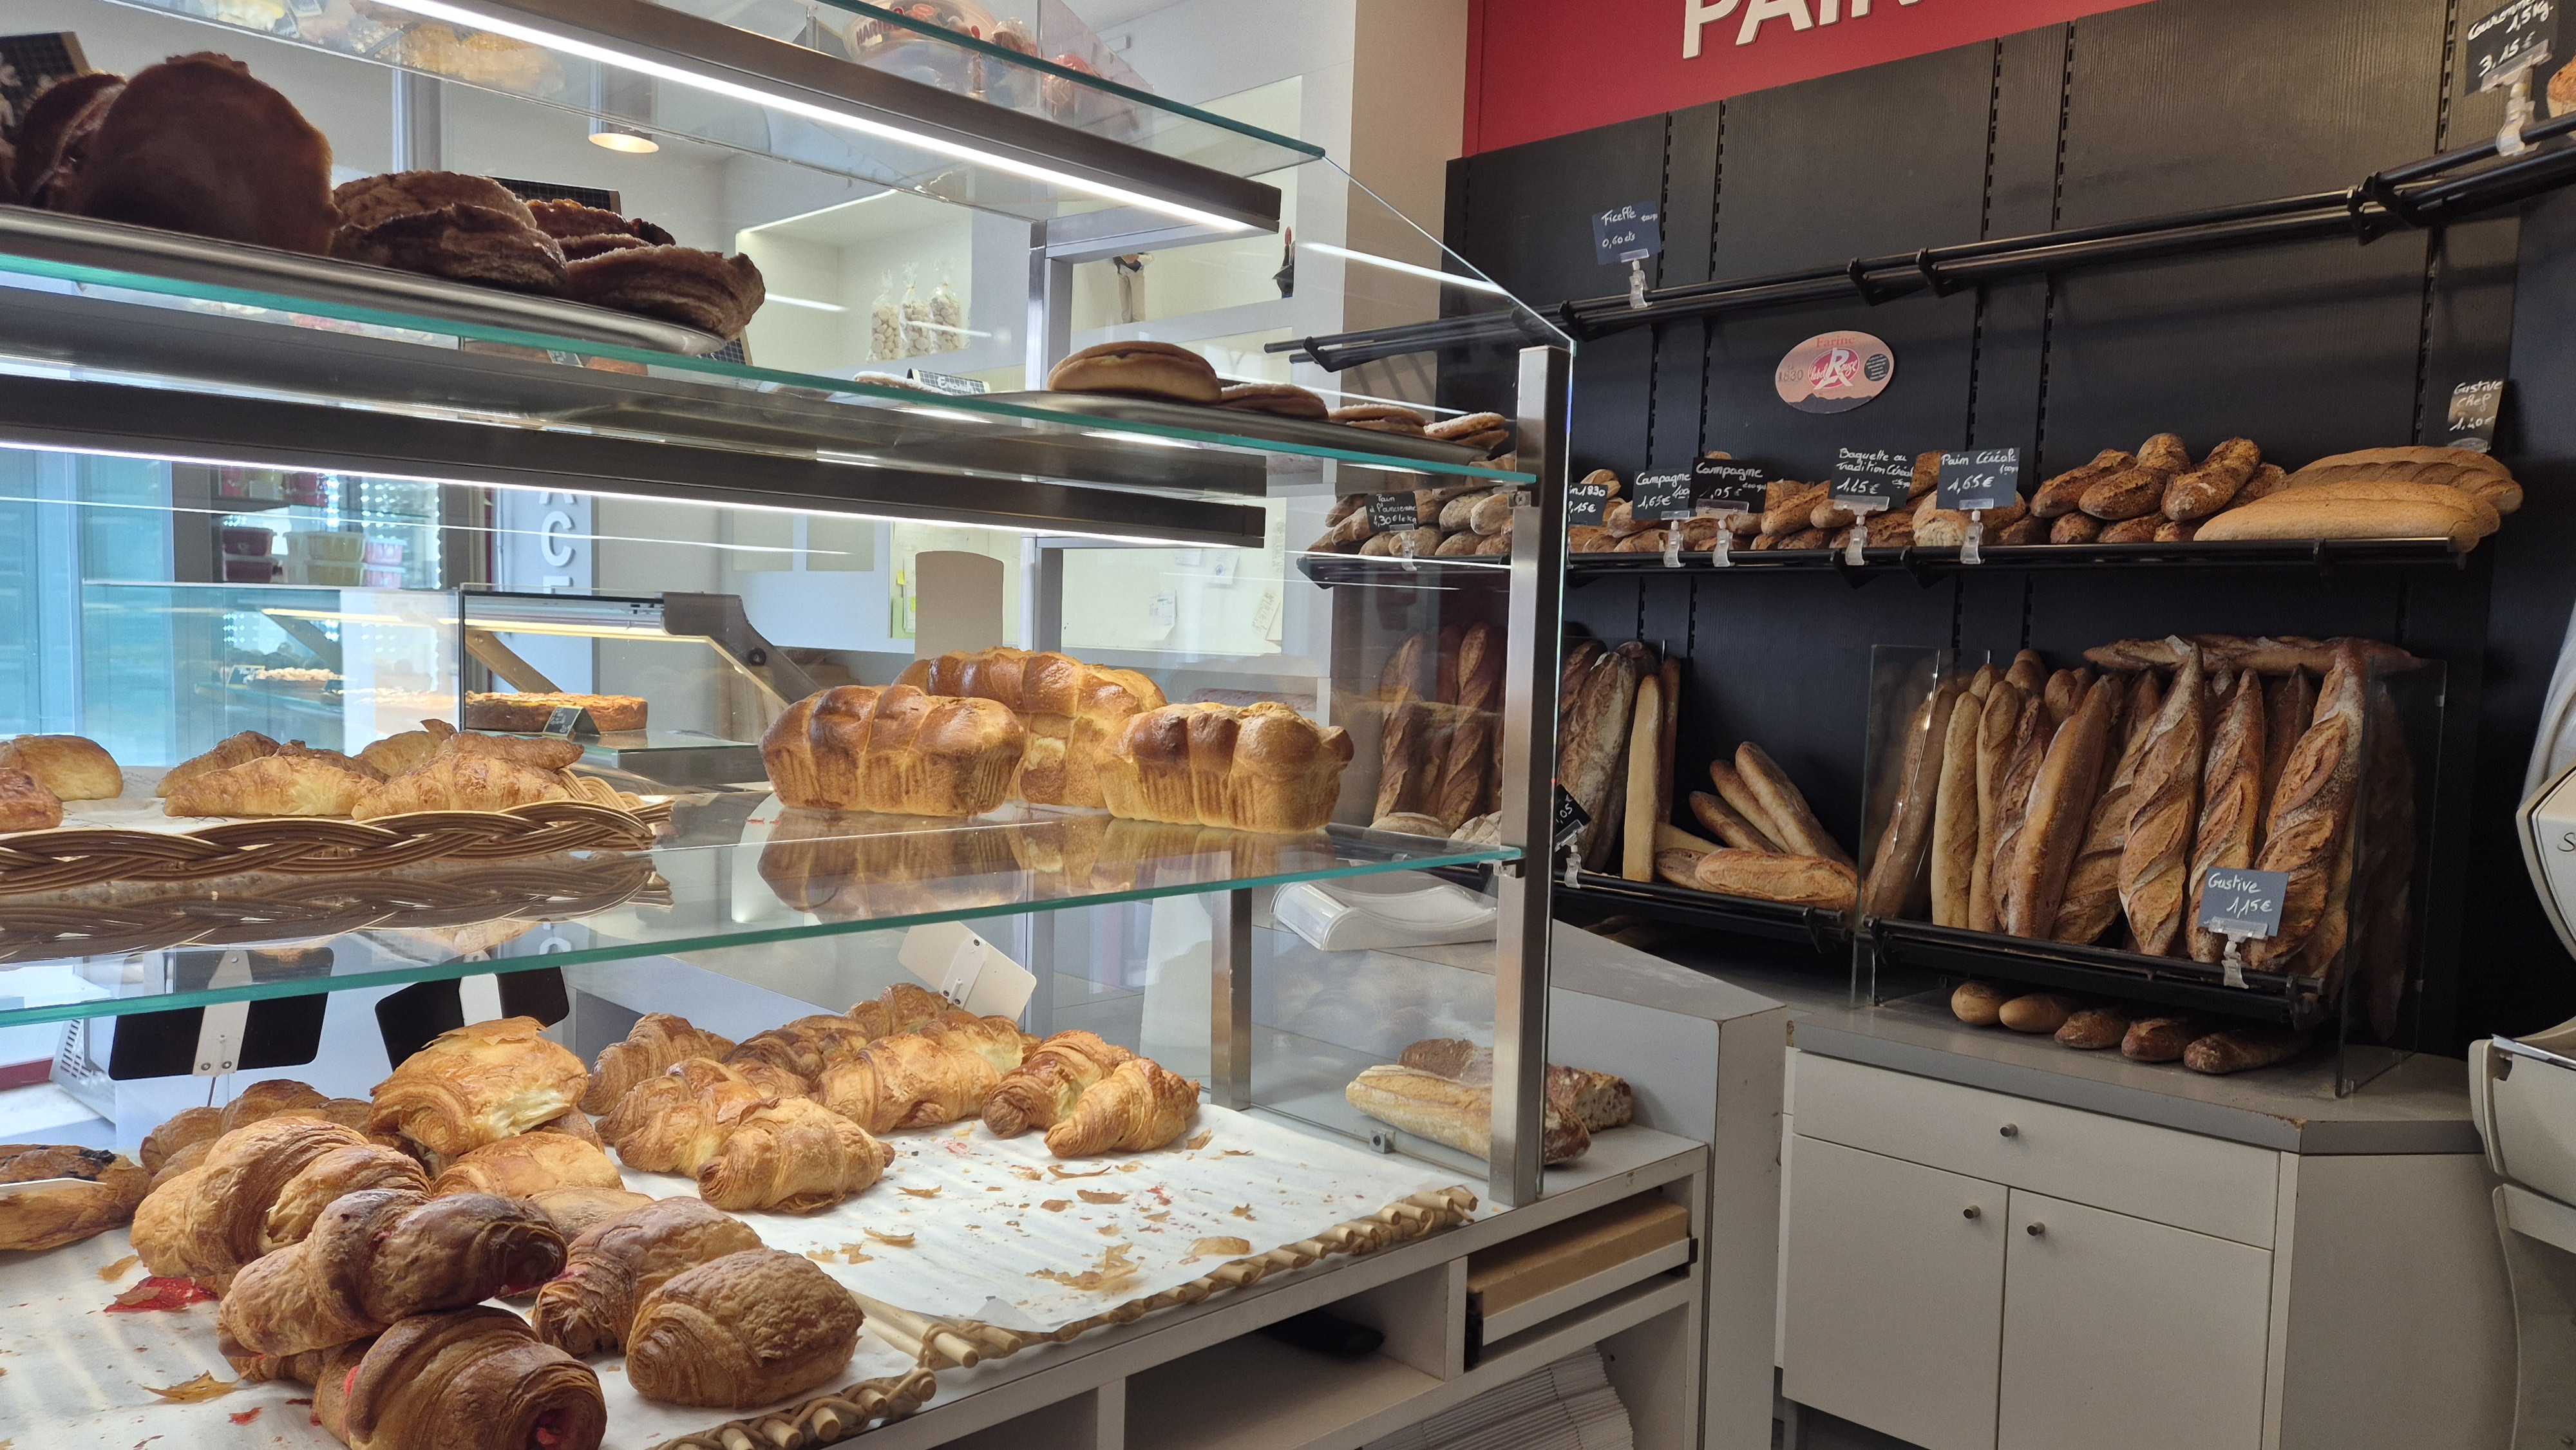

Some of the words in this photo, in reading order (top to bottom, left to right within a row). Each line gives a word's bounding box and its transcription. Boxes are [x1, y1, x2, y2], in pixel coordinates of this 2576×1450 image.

[1816, 336, 1855, 348] Farine
[1778, 369, 1804, 382] 1830
[1941, 453, 1969, 466] Pain
[1696, 462, 1763, 481] Campagne
[1636, 473, 1691, 488] Campagne
[1376, 494, 1396, 502] Pain
[2208, 872, 2262, 894] Gustive
